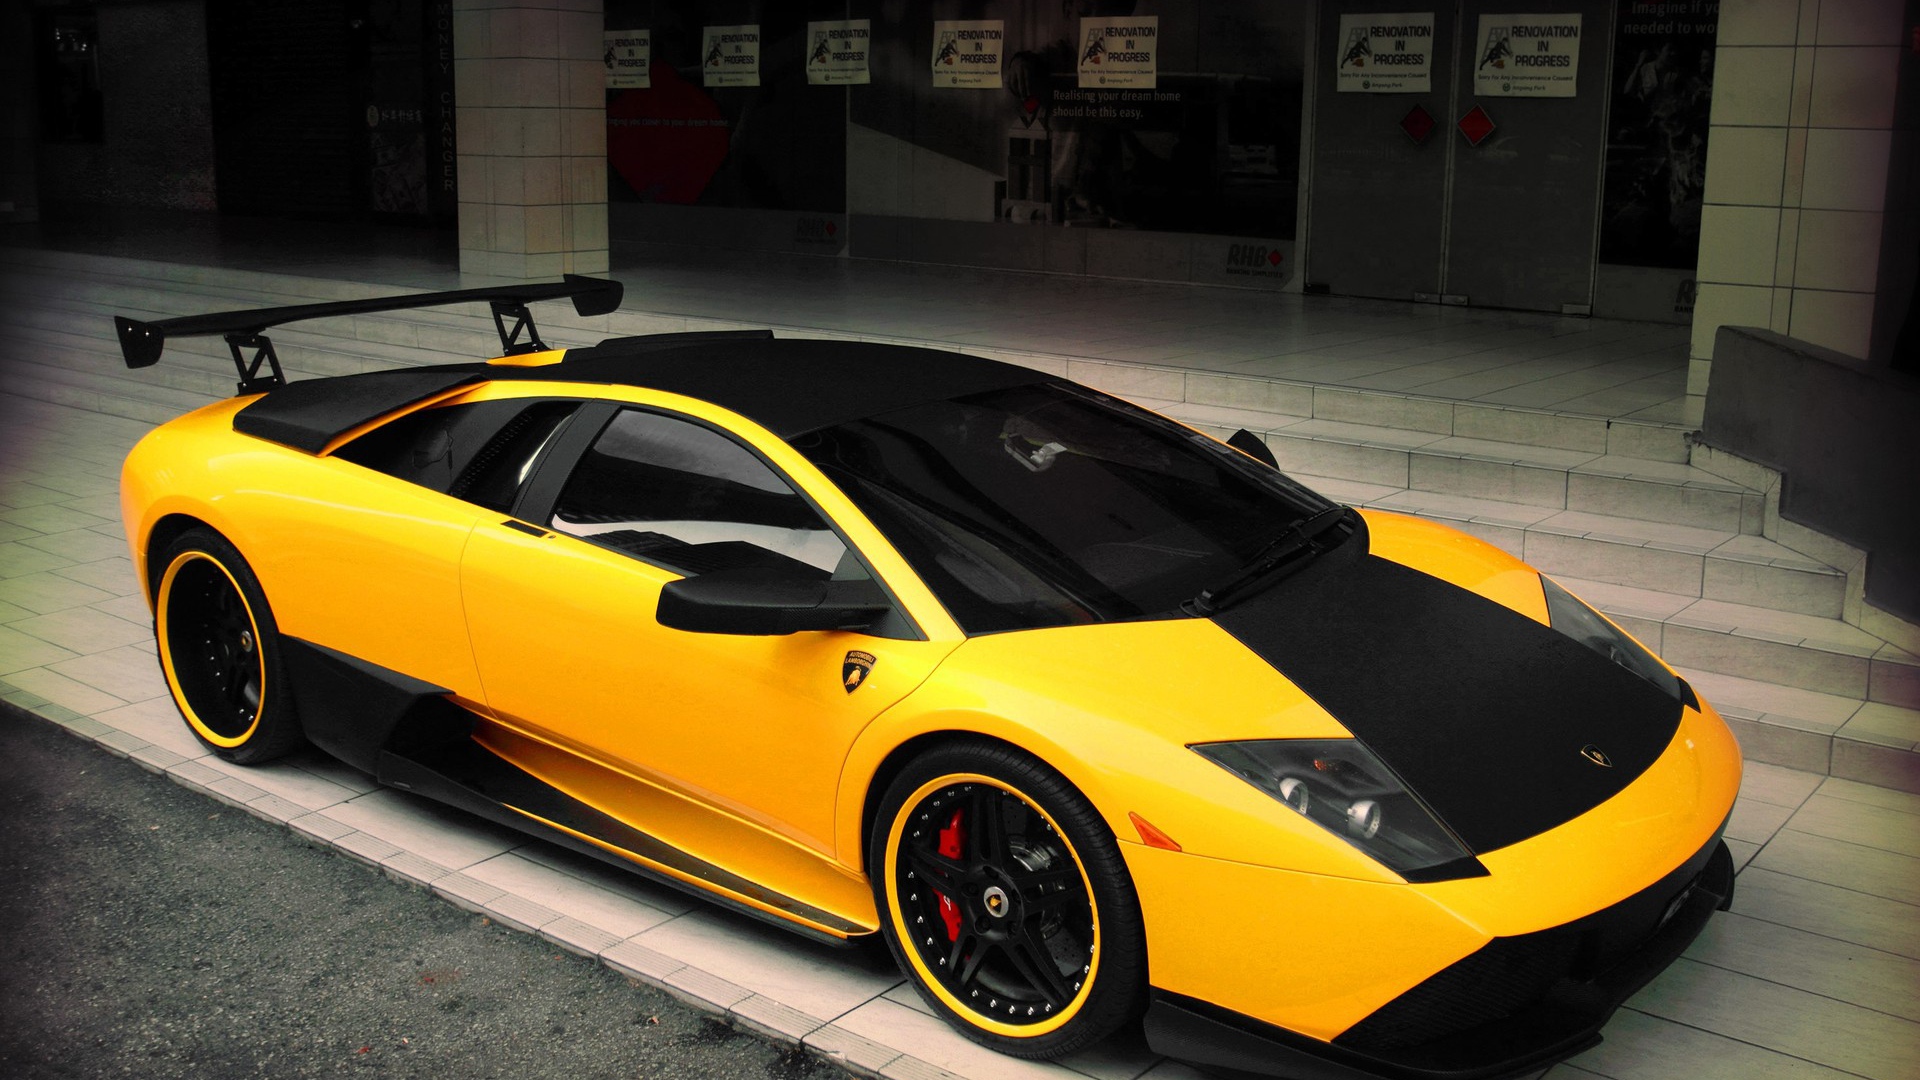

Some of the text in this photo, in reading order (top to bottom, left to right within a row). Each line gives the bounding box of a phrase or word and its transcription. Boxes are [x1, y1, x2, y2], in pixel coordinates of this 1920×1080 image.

[1632, 1, 1687, 17] Imagine
[1691, 0, 1703, 13] if
[1105, 27, 1155, 37] RENOVATION
[1370, 26, 1431, 37] RENOVATION
[1512, 26, 1578, 37] RENOVATION
[1624, 21, 1673, 34] needed
[1677, 22, 1691, 34] to
[721, 34, 758, 43] RENOVATION
[829, 29, 868, 39] RENOVATION
[958, 30, 1001, 40] RENOVATION
[735, 45, 742, 53] IN
[845, 41, 851, 49] IN
[975, 42, 982, 51] IN
[1126, 40, 1134, 49] IN
[1395, 40, 1405, 51] IN
[1538, 41, 1549, 52] IN
[628, 49, 635, 57] IN
[833, 52, 864, 61] PROGRESS
[1108, 53, 1150, 62] PROGRESS
[618, 59, 646, 67] PROGRESS
[724, 56, 754, 64] PROGRESS
[961, 54, 997, 63] PROGRESS
[1374, 54, 1424, 65] PROGRESS
[1515, 55, 1570, 67] PROGRESS
[437, 4, 454, 191] MONEY CHANGER
[1054, 90, 1181, 103] Realising your dream home
[1053, 107, 1143, 119] should be this easy.
[1227, 244, 1267, 267] RHB
